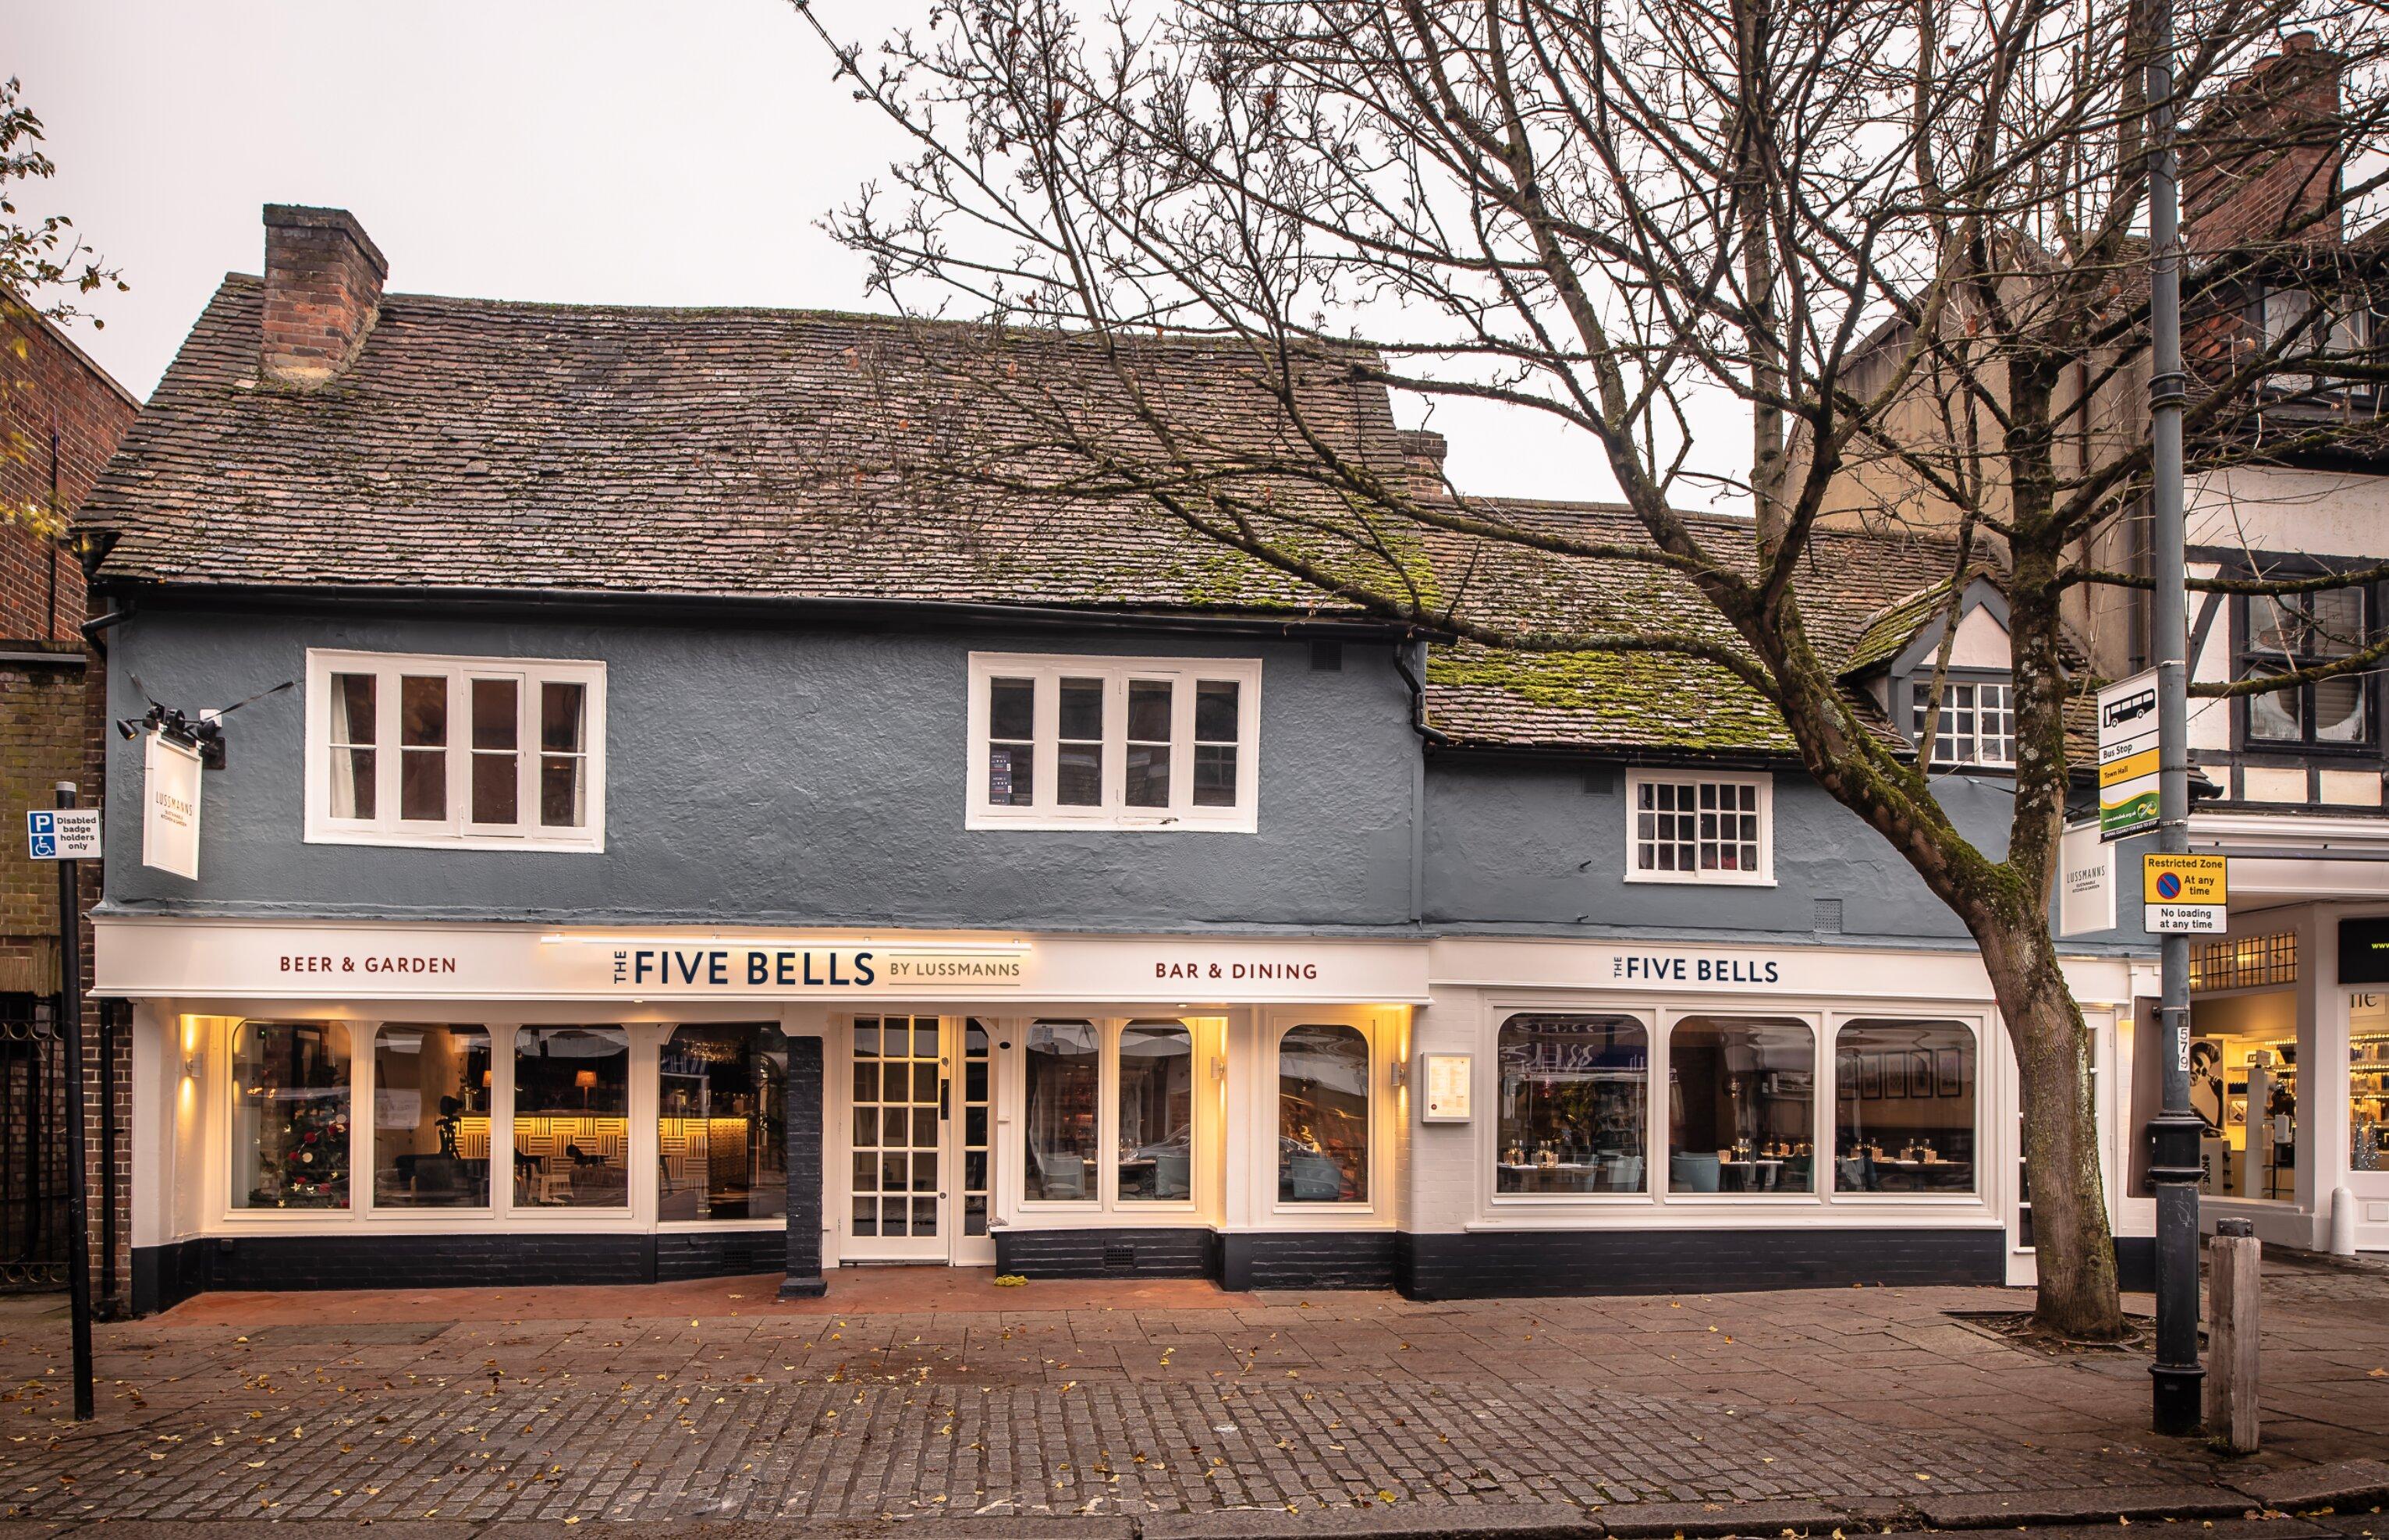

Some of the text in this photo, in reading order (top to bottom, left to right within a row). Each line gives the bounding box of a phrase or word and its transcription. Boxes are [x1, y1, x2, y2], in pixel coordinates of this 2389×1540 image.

[2103, 743, 2133, 759] Bus Stop
[2104, 765, 2128, 779] Town Hall
[156, 790, 193, 817] LUSSMANNS
[36, 815, 51, 832] P
[2148, 859, 2223, 868] Restricted Zone
[2066, 865, 2106, 884] LUSSMANNS
[2185, 875, 2214, 886] At any
[2189, 886, 2210, 896] time
[2161, 908, 2211, 918] No loading
[2160, 920, 2170, 928] at
[2192, 920, 2213, 928] time
[280, 956, 456, 974] BEER & GARDEN
[614, 951, 627, 985] THE
[635, 951, 875, 986] FIVE BELLS
[889, 963, 1021, 978] BY LUSSMANNS
[1155, 963, 1318, 980] BAR & DINING
[1613, 956, 1622, 978] THE
[1627, 956, 1779, 984] FIVE BELLS
[2202, 1162, 2211, 1184] KENT
